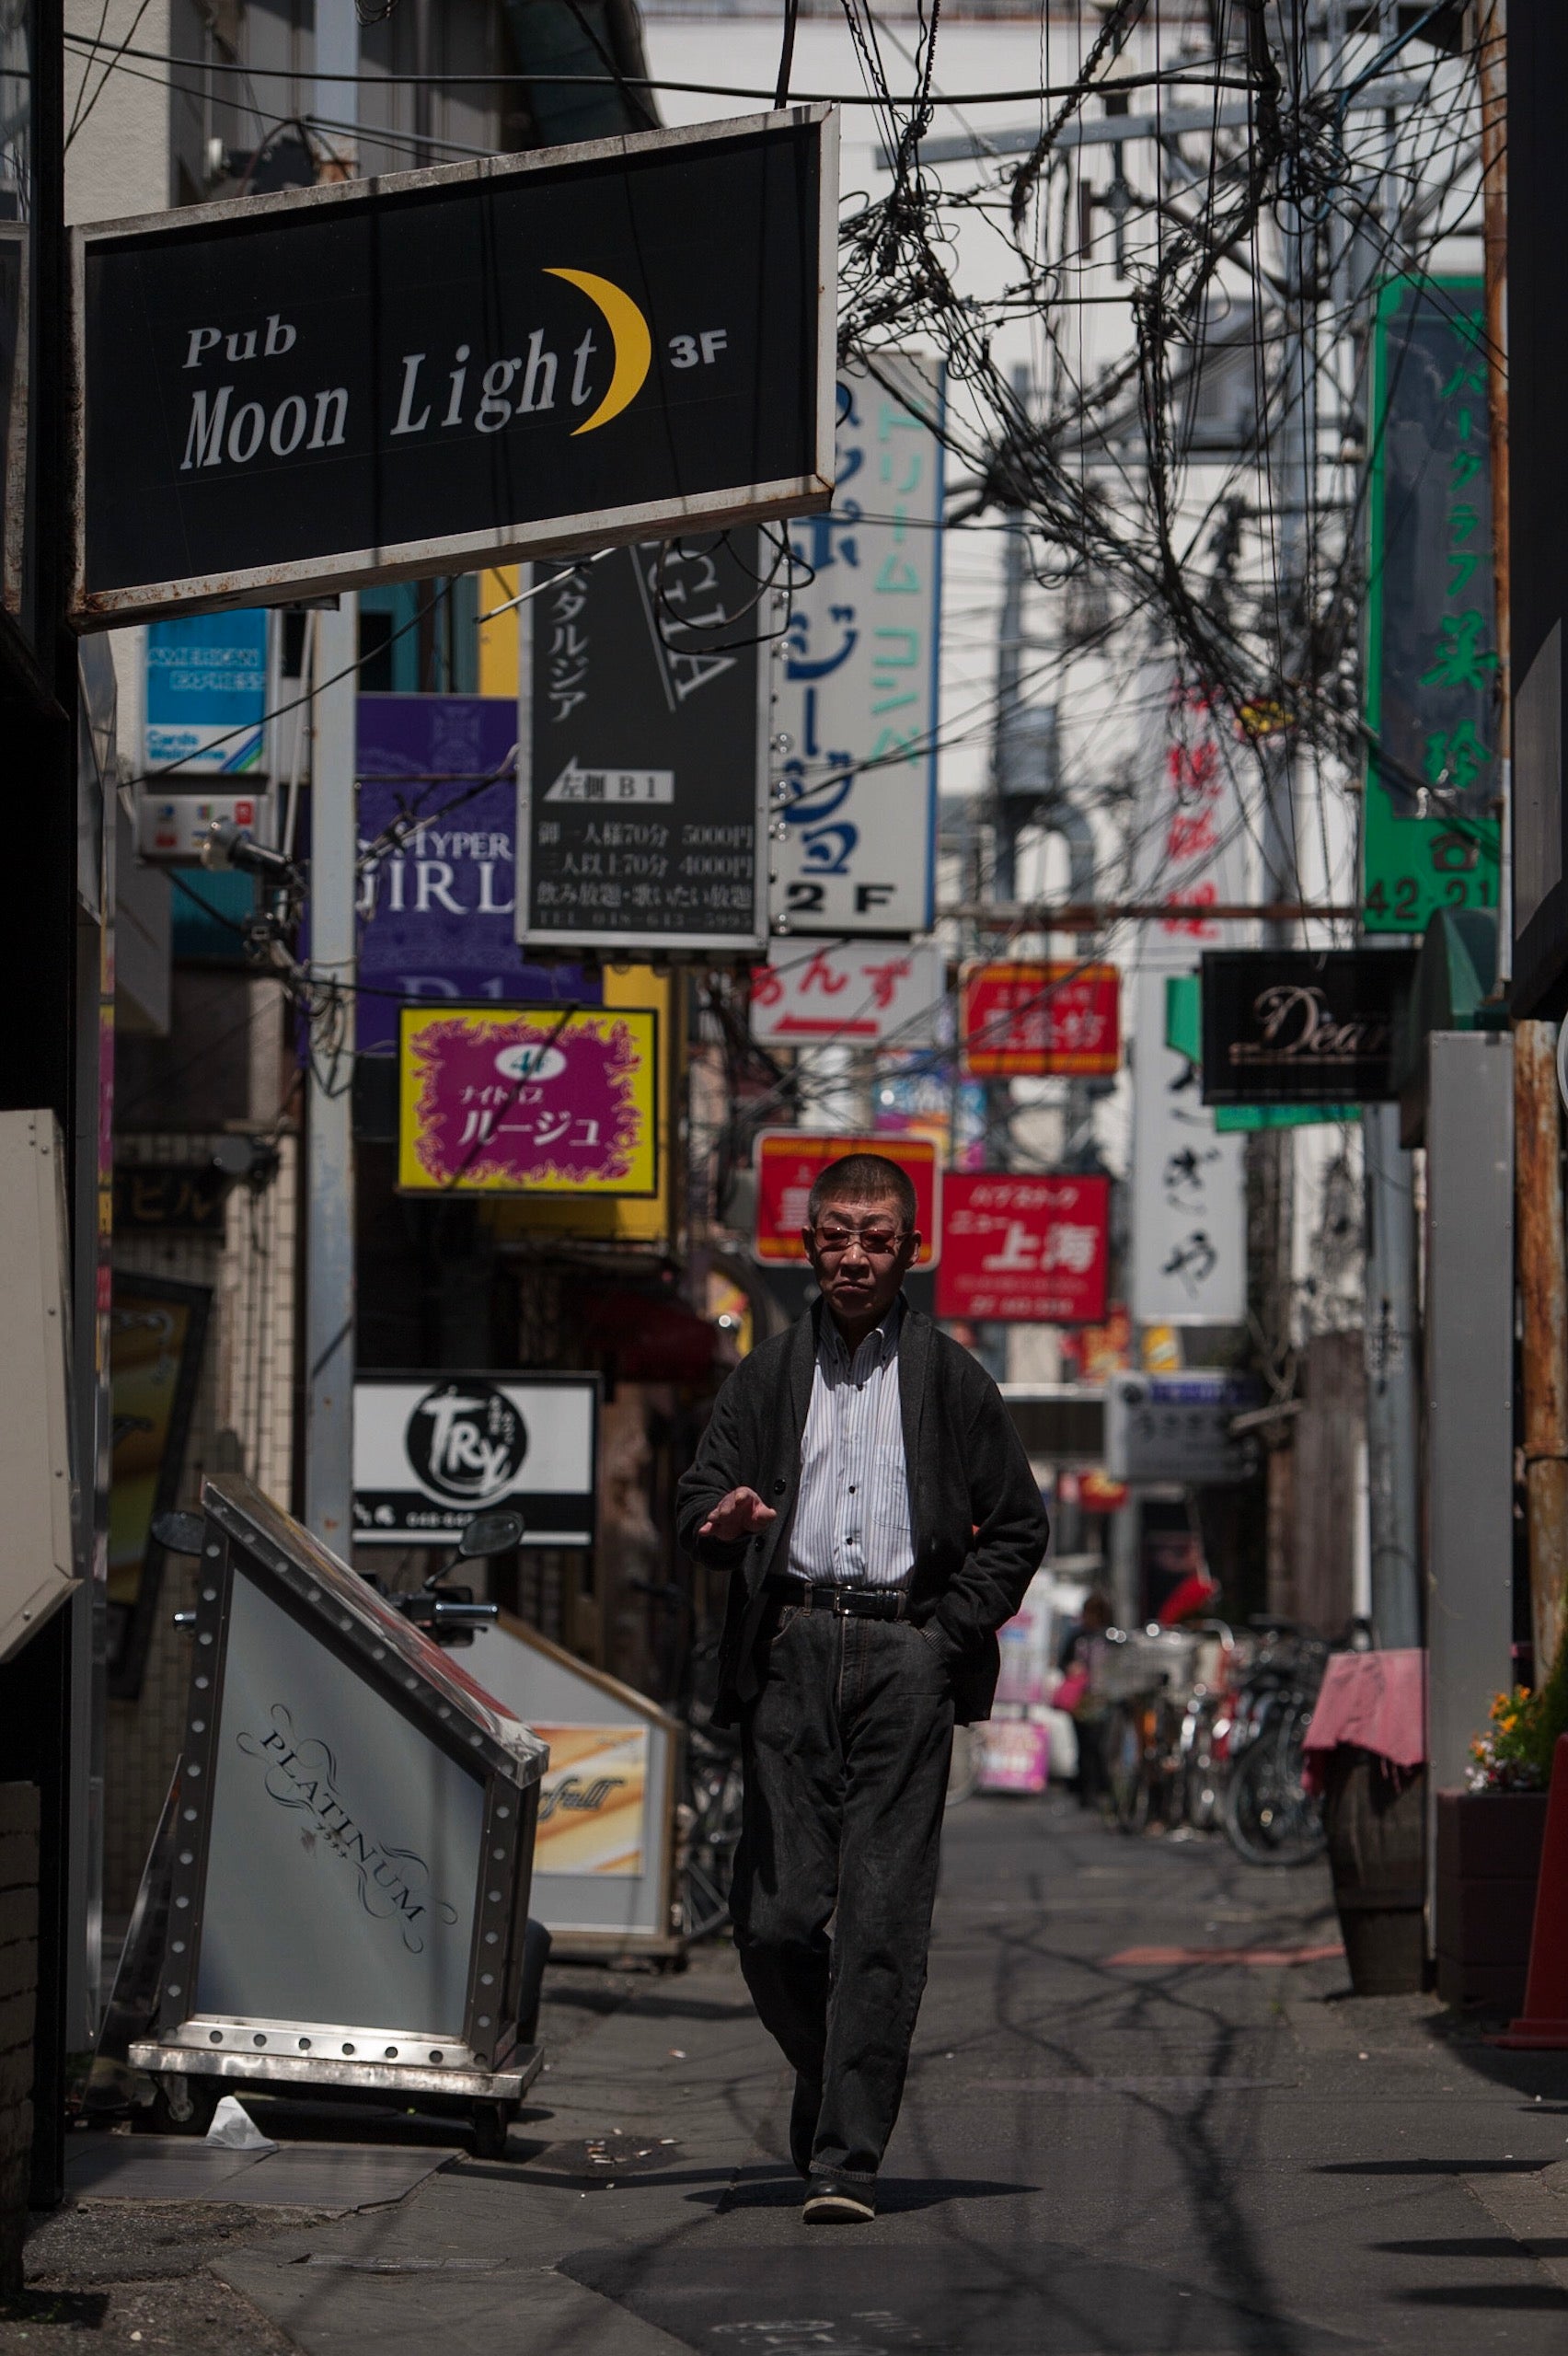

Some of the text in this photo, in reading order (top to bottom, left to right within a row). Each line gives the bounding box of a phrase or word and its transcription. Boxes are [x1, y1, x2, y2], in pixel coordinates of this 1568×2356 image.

[179, 328, 728, 471] Moon Light 3F
[181, 314, 297, 369] Pub
[640, 542, 739, 702] GIA
[457, 1109, 601, 1147] ルージュ
[260, 1729, 425, 1922] PLATINUM
